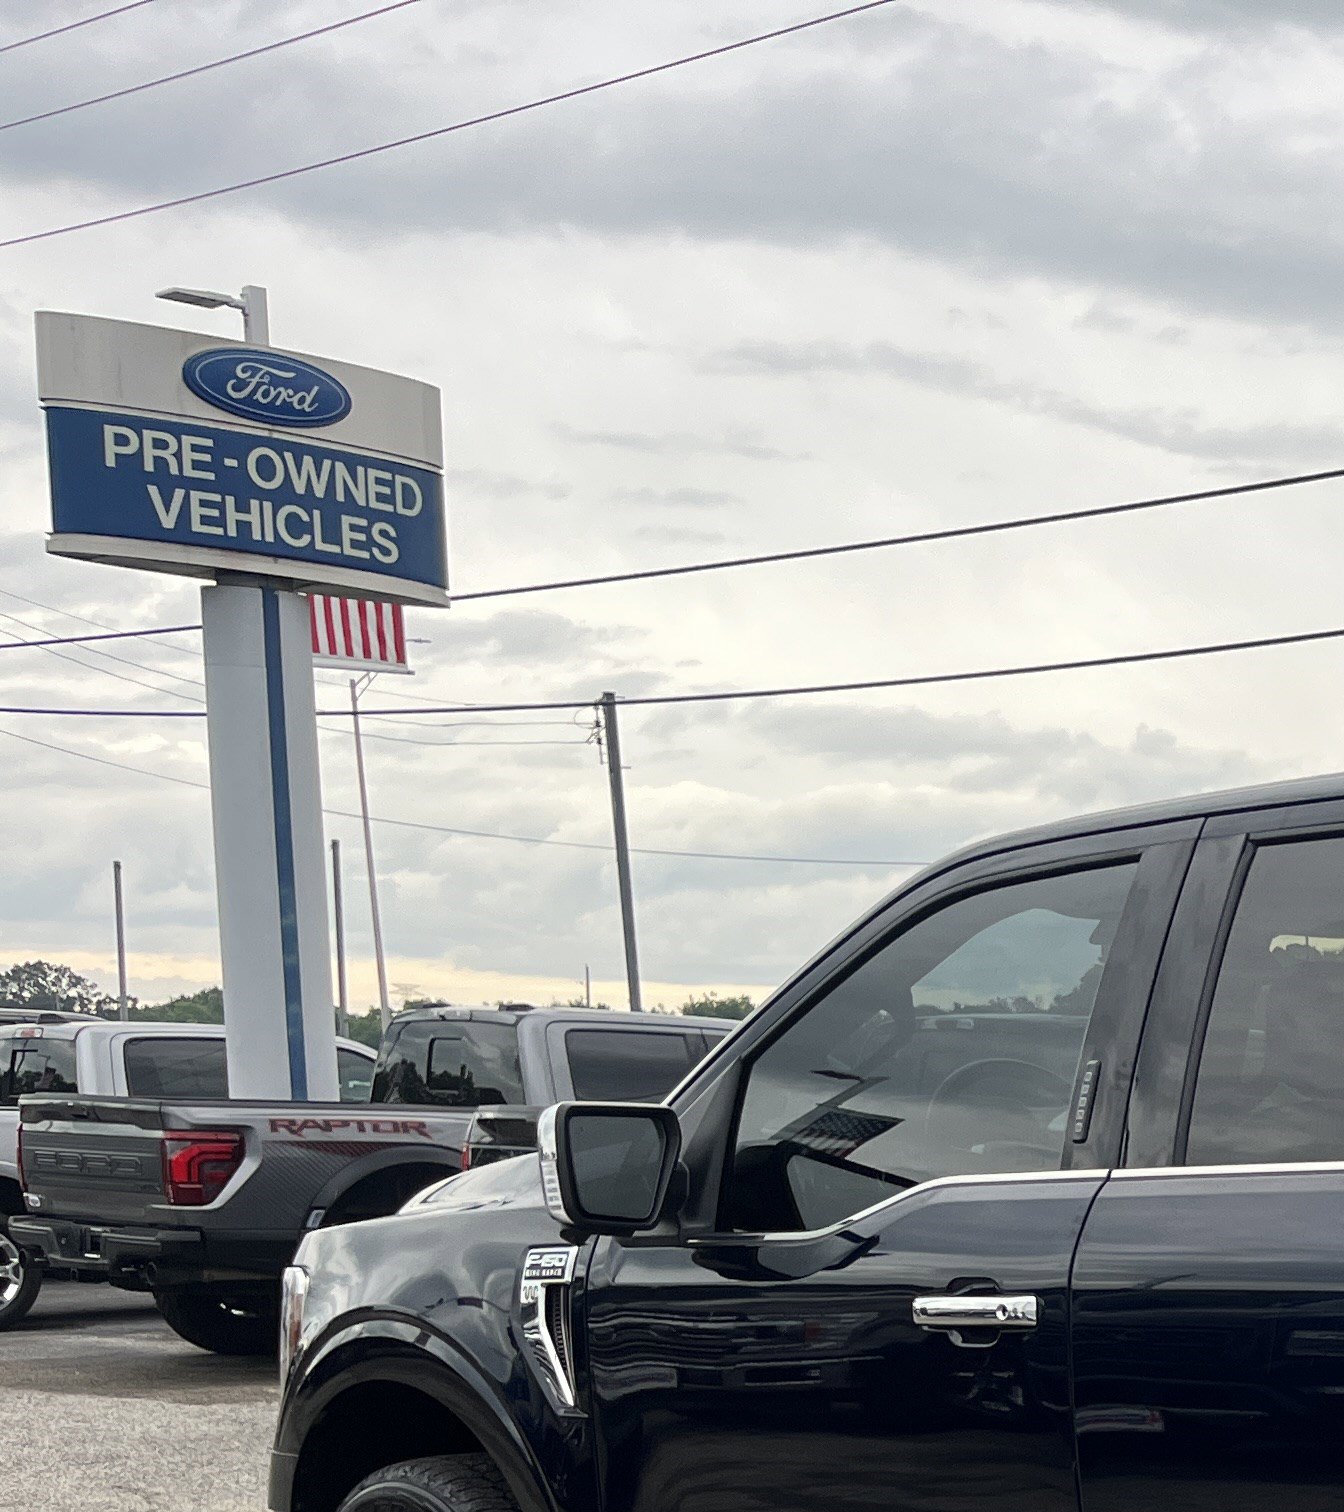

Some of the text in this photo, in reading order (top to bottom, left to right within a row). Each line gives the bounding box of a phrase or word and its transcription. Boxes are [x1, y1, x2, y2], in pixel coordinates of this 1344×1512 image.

[226, 361, 319, 414] Ford
[147, 484, 399, 565] VEHICLES
[268, 1118, 433, 1141] RAPTOR
